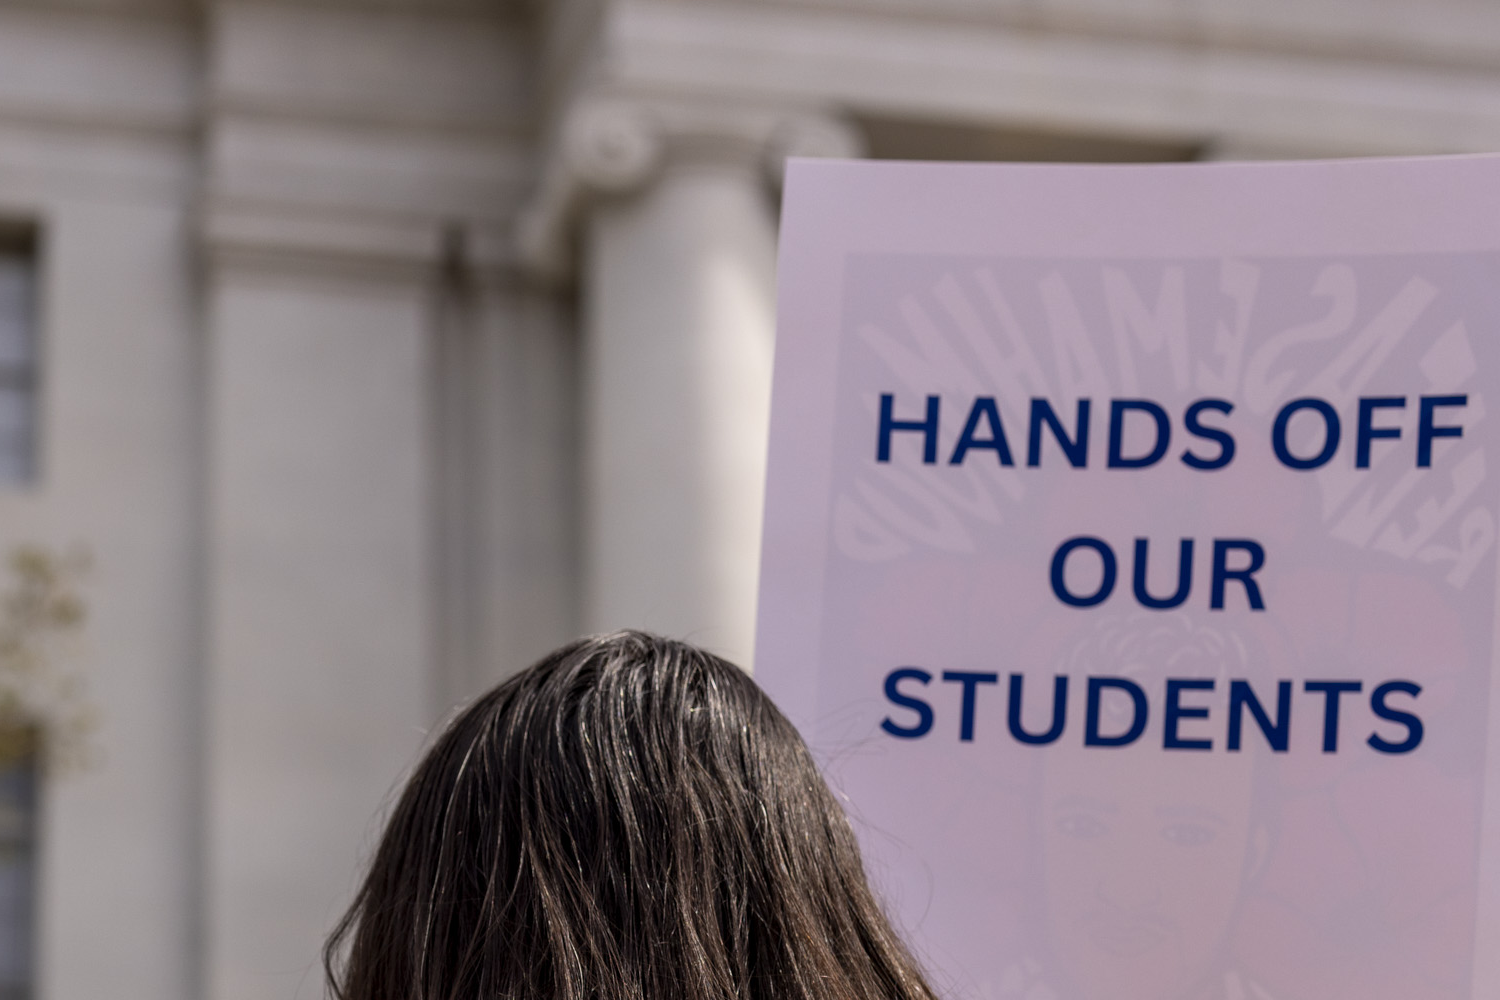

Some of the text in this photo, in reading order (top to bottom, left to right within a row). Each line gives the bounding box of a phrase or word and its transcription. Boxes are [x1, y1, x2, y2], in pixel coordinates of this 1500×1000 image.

[875, 392, 1469, 471] HANDS OFF
[1049, 534, 1267, 611] OUR
[879, 666, 1425, 754] STUDENTS
